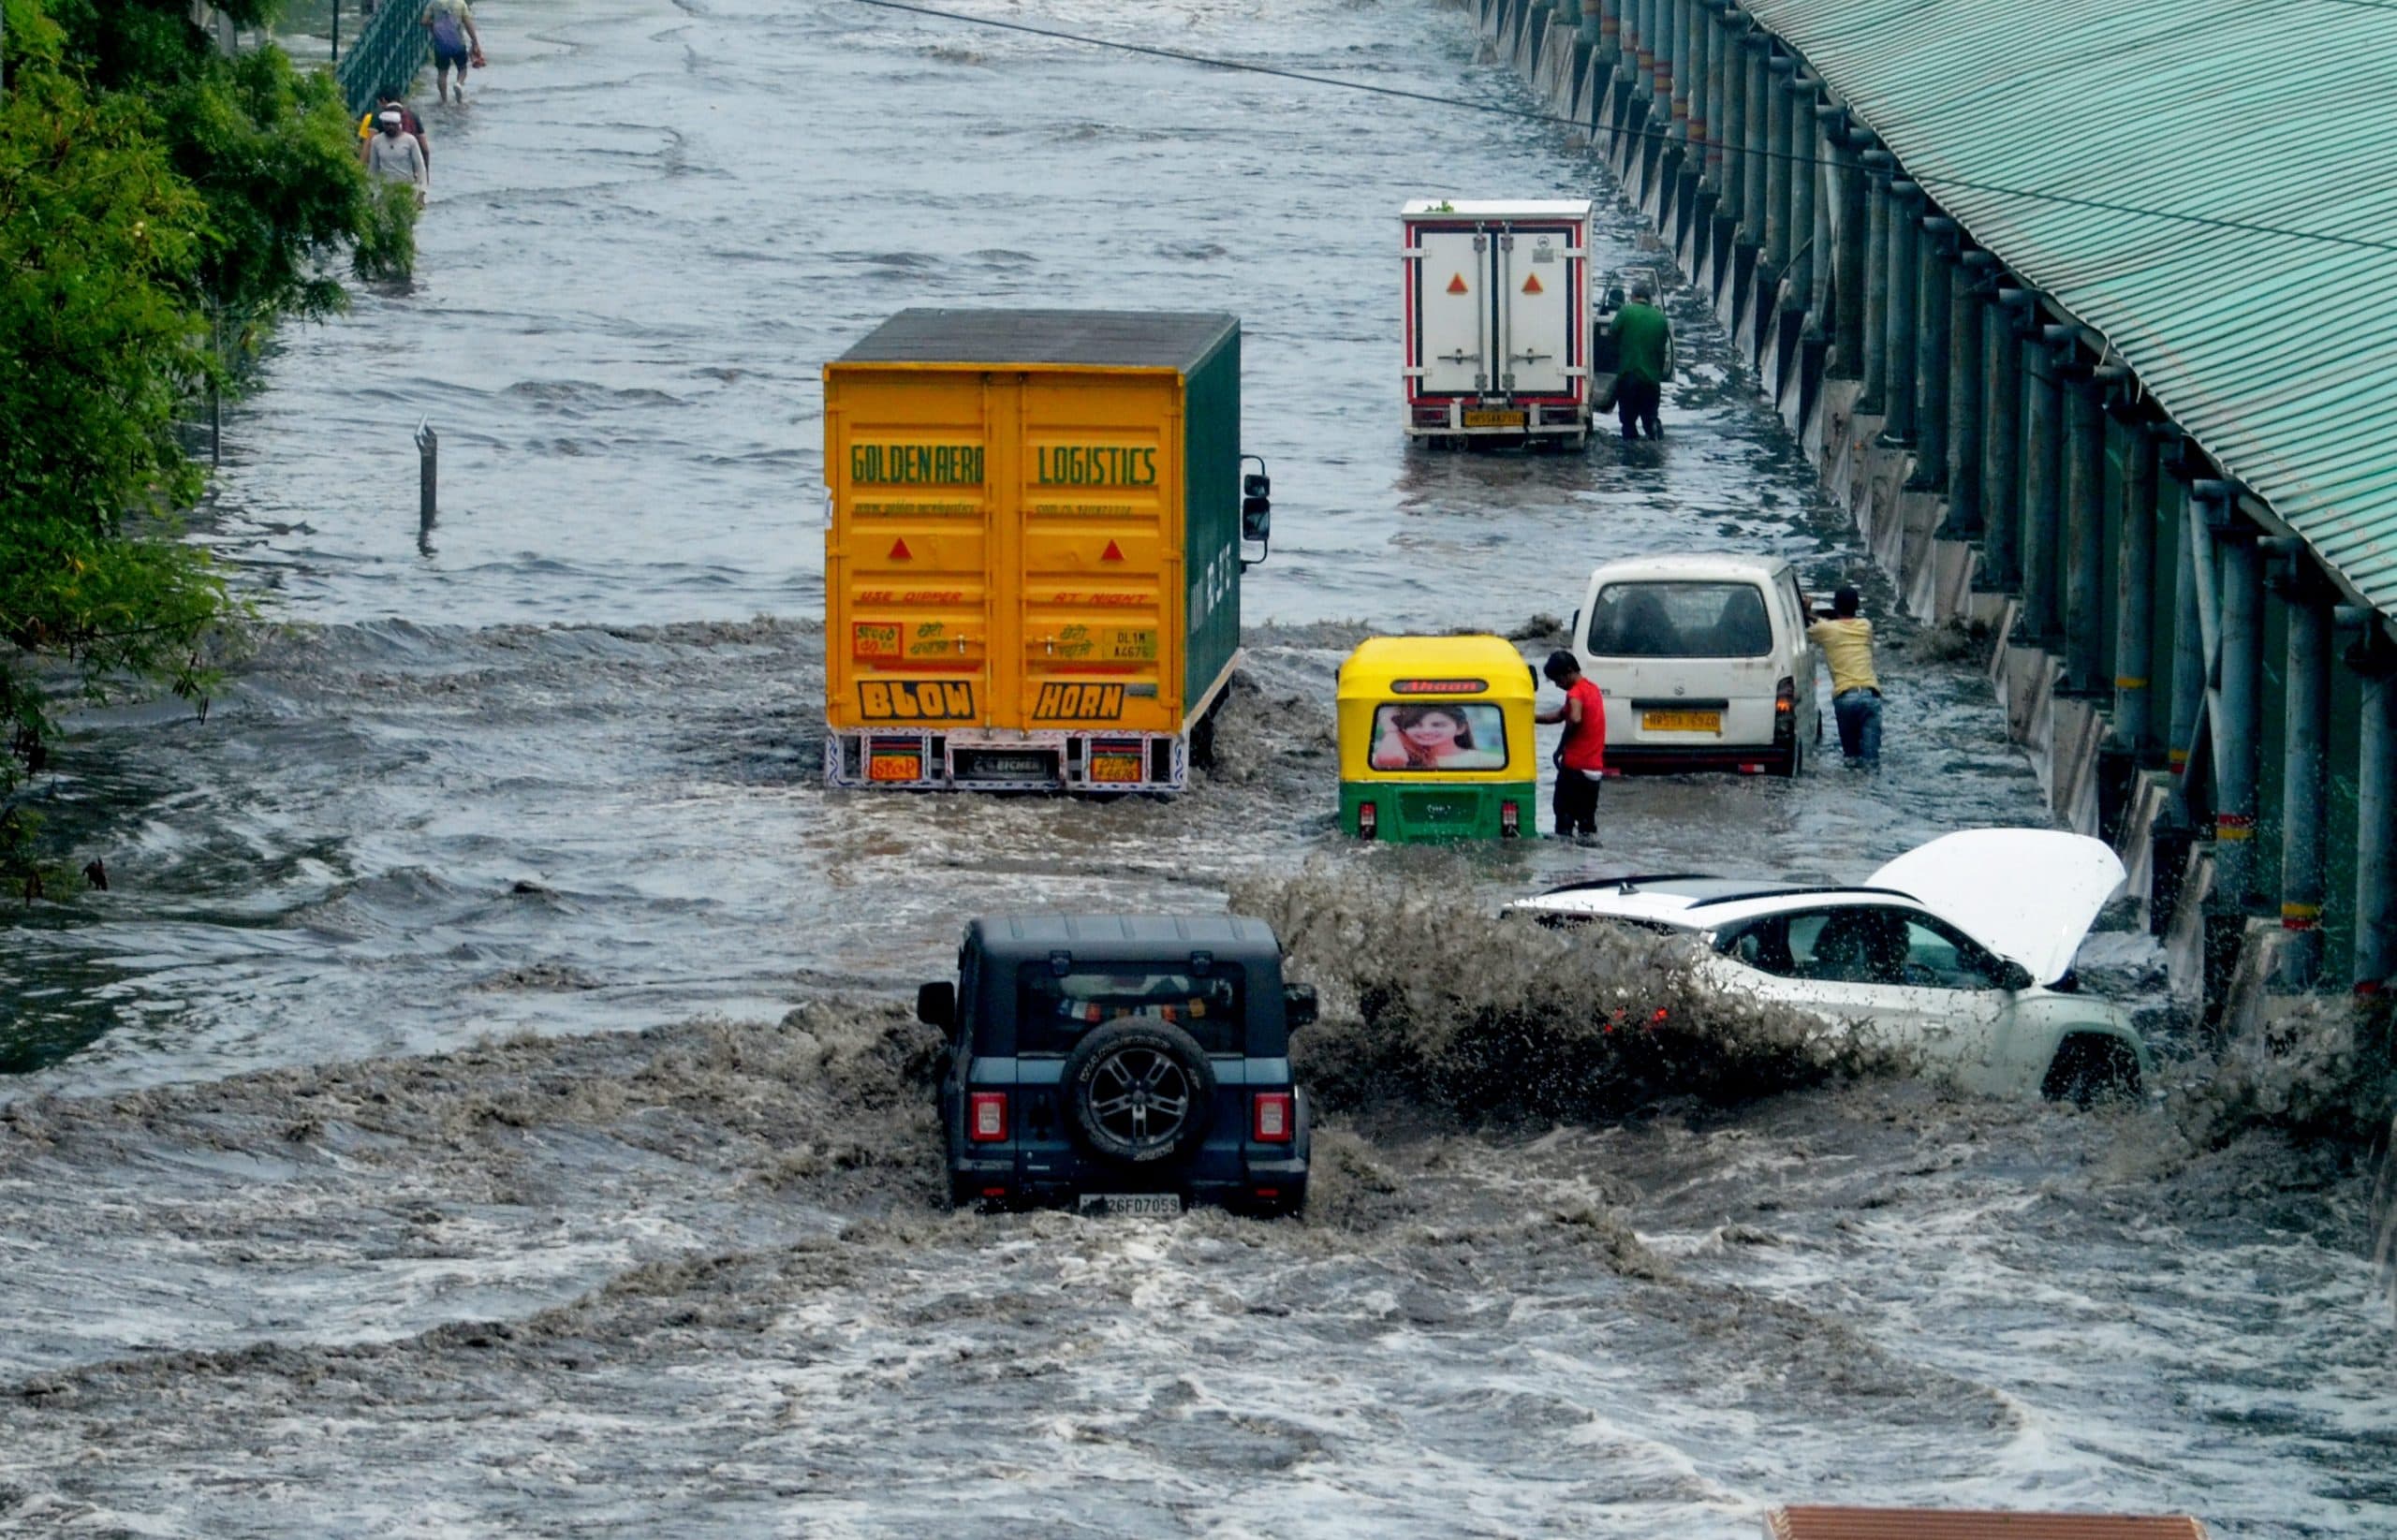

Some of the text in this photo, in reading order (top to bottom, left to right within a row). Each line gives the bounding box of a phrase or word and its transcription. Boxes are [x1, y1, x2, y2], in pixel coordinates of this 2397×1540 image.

[1038, 447, 1156, 484] LOGISTICS
[860, 591, 963, 603] USE DIPPER
[1054, 592, 1149, 604] AT NIGHT
[860, 682, 972, 718] BLOW
[1035, 684, 1123, 718] HORN
